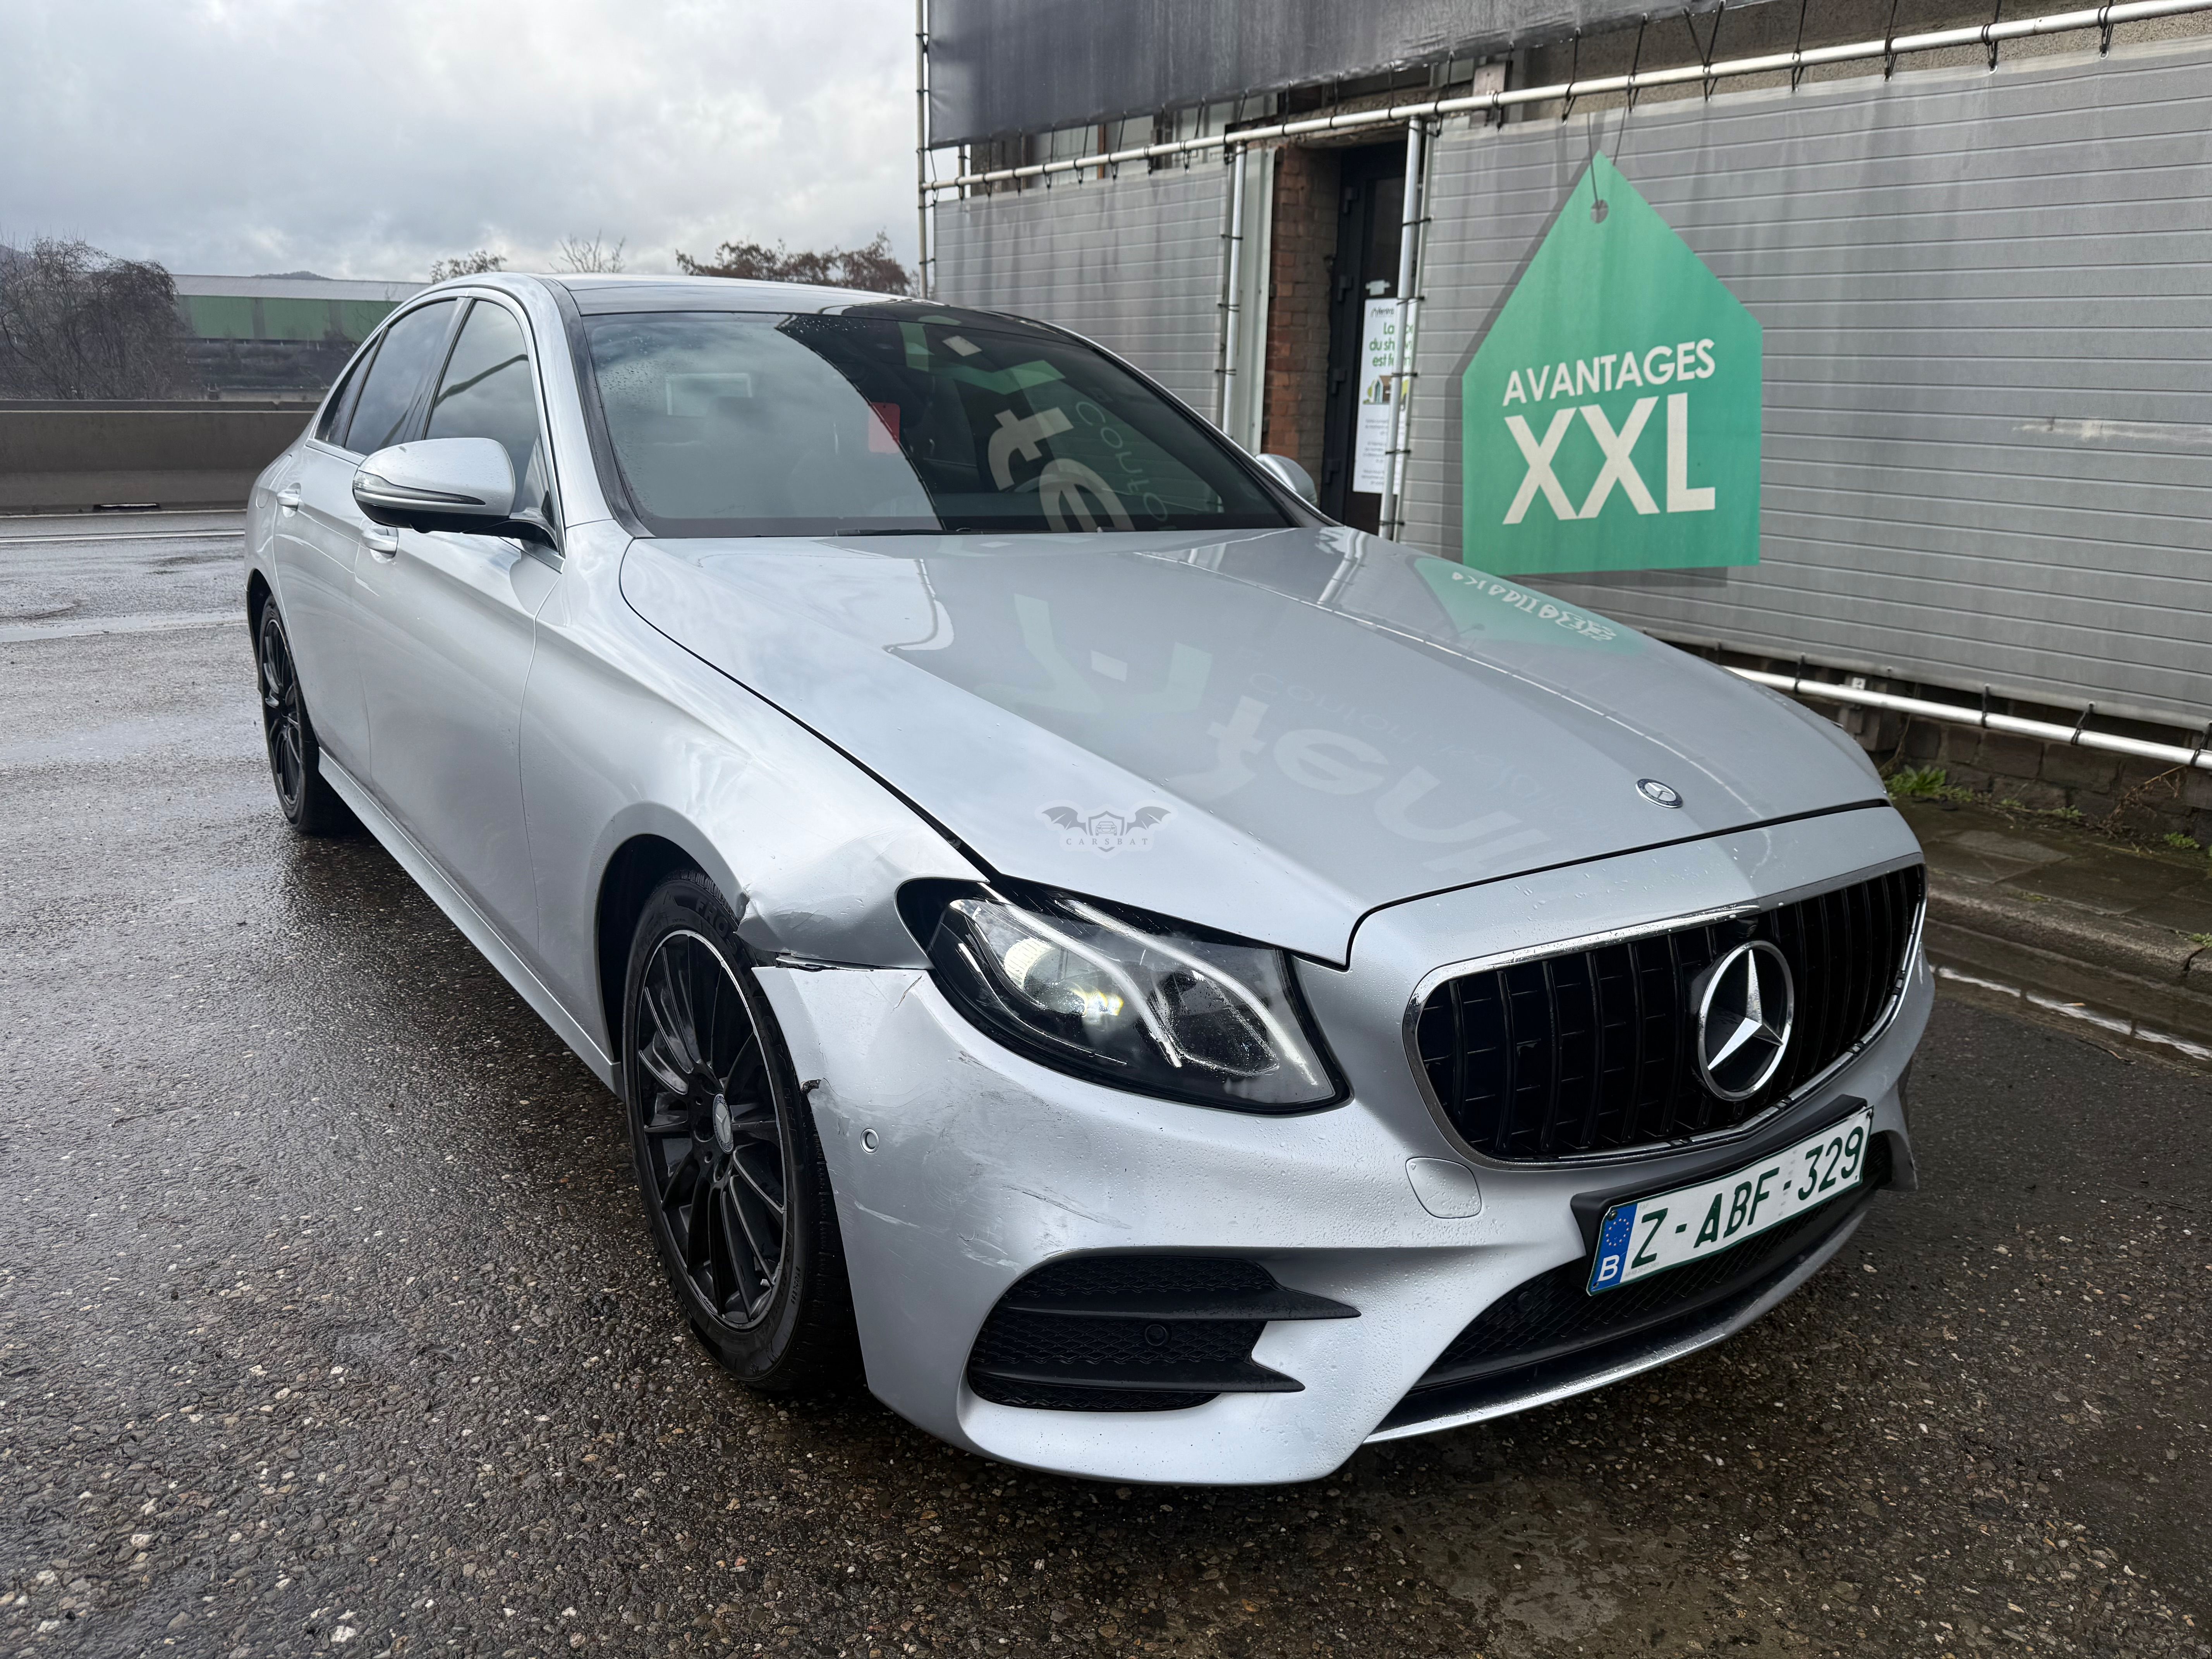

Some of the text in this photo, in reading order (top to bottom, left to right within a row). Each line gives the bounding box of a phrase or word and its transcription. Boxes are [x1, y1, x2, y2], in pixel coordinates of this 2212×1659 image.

[1502, 338, 1715, 406] AVANTAGES
[1502, 392, 1715, 524] XXL
[1631, 1126, 1863, 1269] Z-ABF-329
[1598, 1254, 1619, 1282] B
